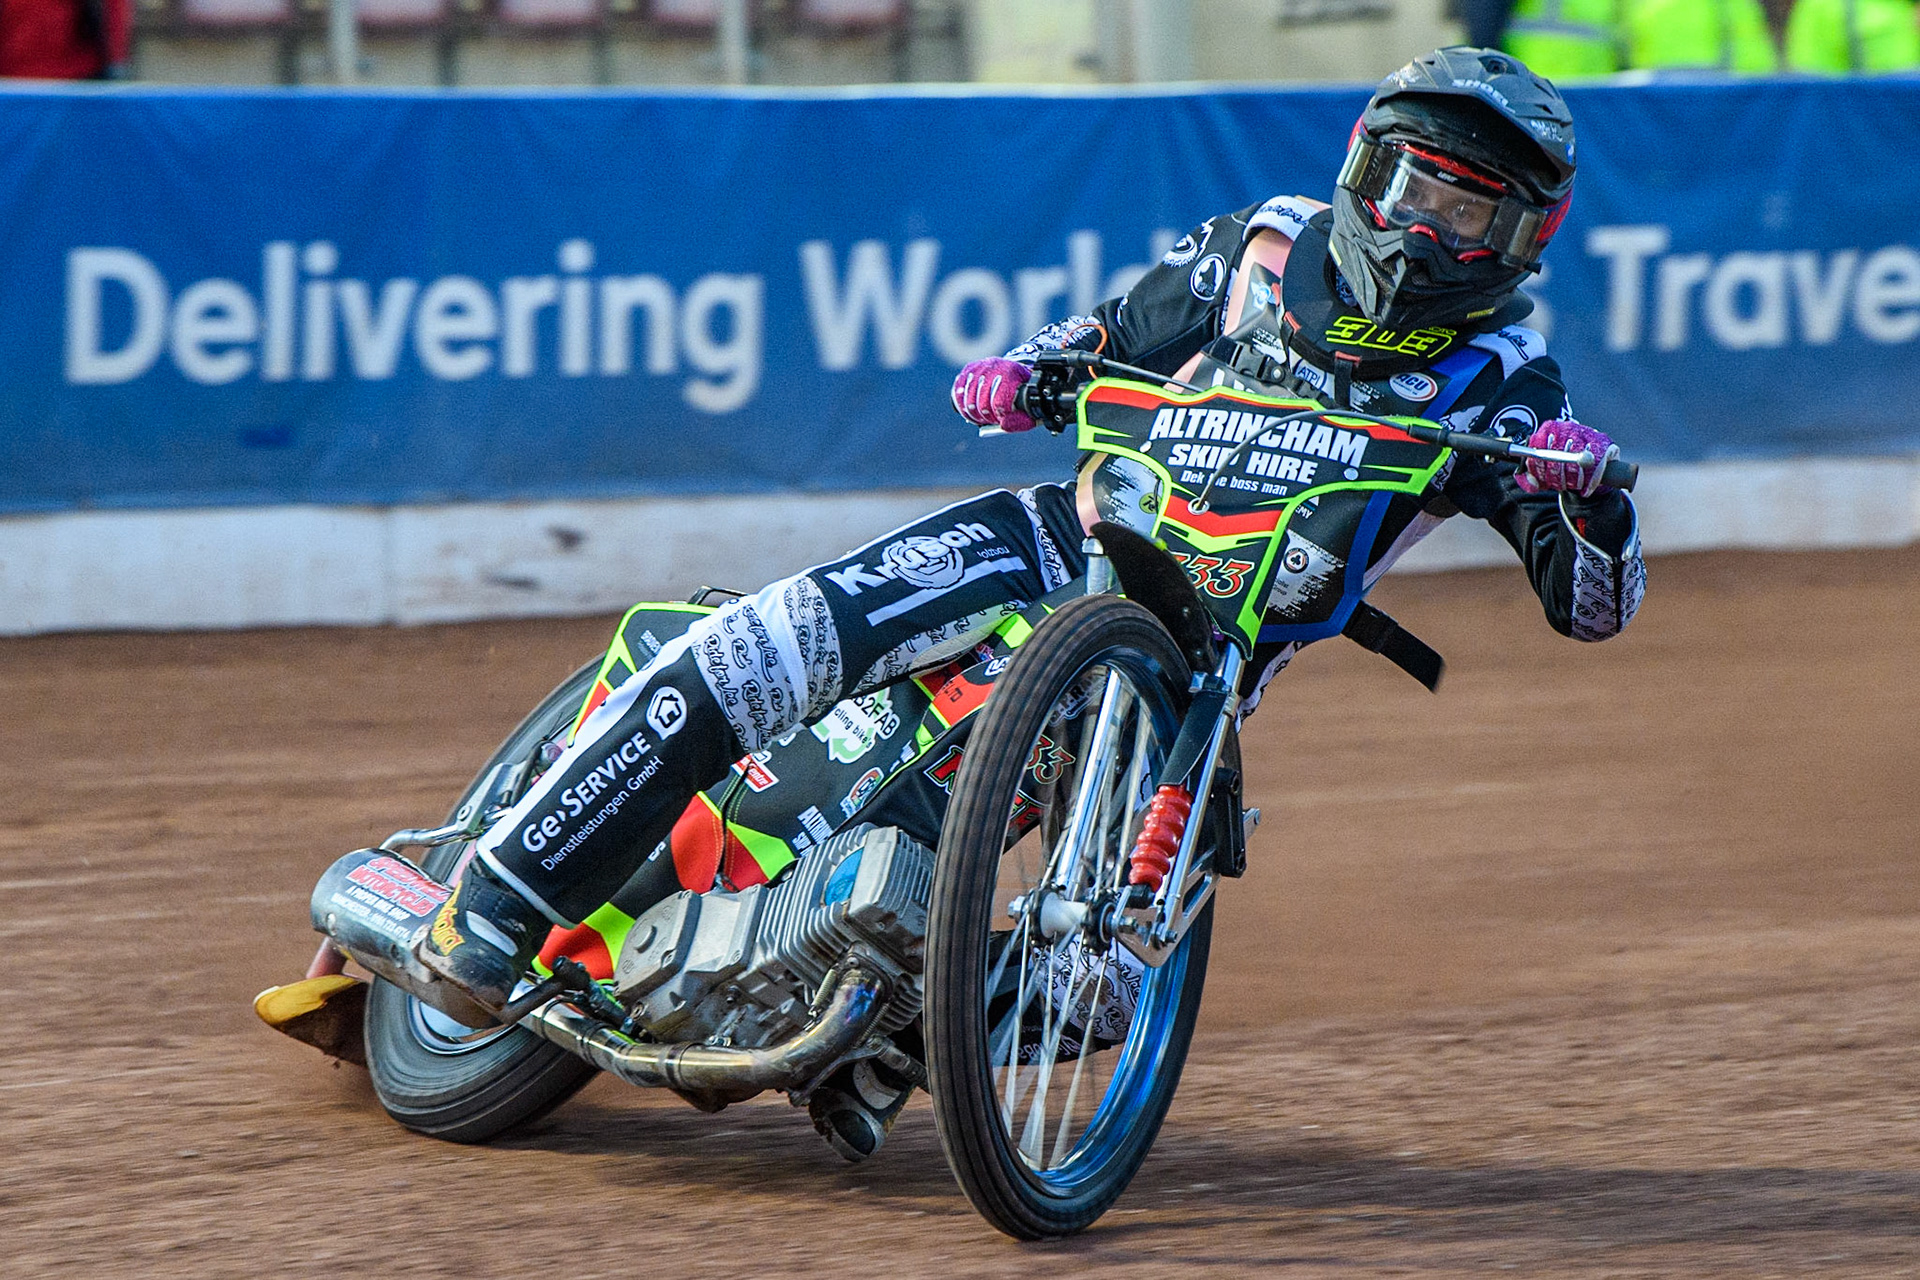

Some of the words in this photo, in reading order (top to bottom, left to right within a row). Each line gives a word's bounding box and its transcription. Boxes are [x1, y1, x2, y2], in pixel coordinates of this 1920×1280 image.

[65, 238, 764, 413] Delivering
[1297, 366, 1321, 387] ATPI
[1395, 373, 1430, 392] ACU
[1149, 407, 1370, 469] ALTRINGHAM
[1167, 443, 1241, 470] SKIP
[1244, 450, 1319, 485] HIRE
[1180, 469, 1206, 485] Dek
[1229, 478, 1260, 492] boss
[1261, 482, 1288, 497] man
[1172, 551, 1255, 599] 33
[833, 705, 854, 730] cling
[540, 790, 631, 872] Dienstleistungen
[625, 755, 665, 792] GmbH
[346, 864, 439, 918] MOTORCYCLES
